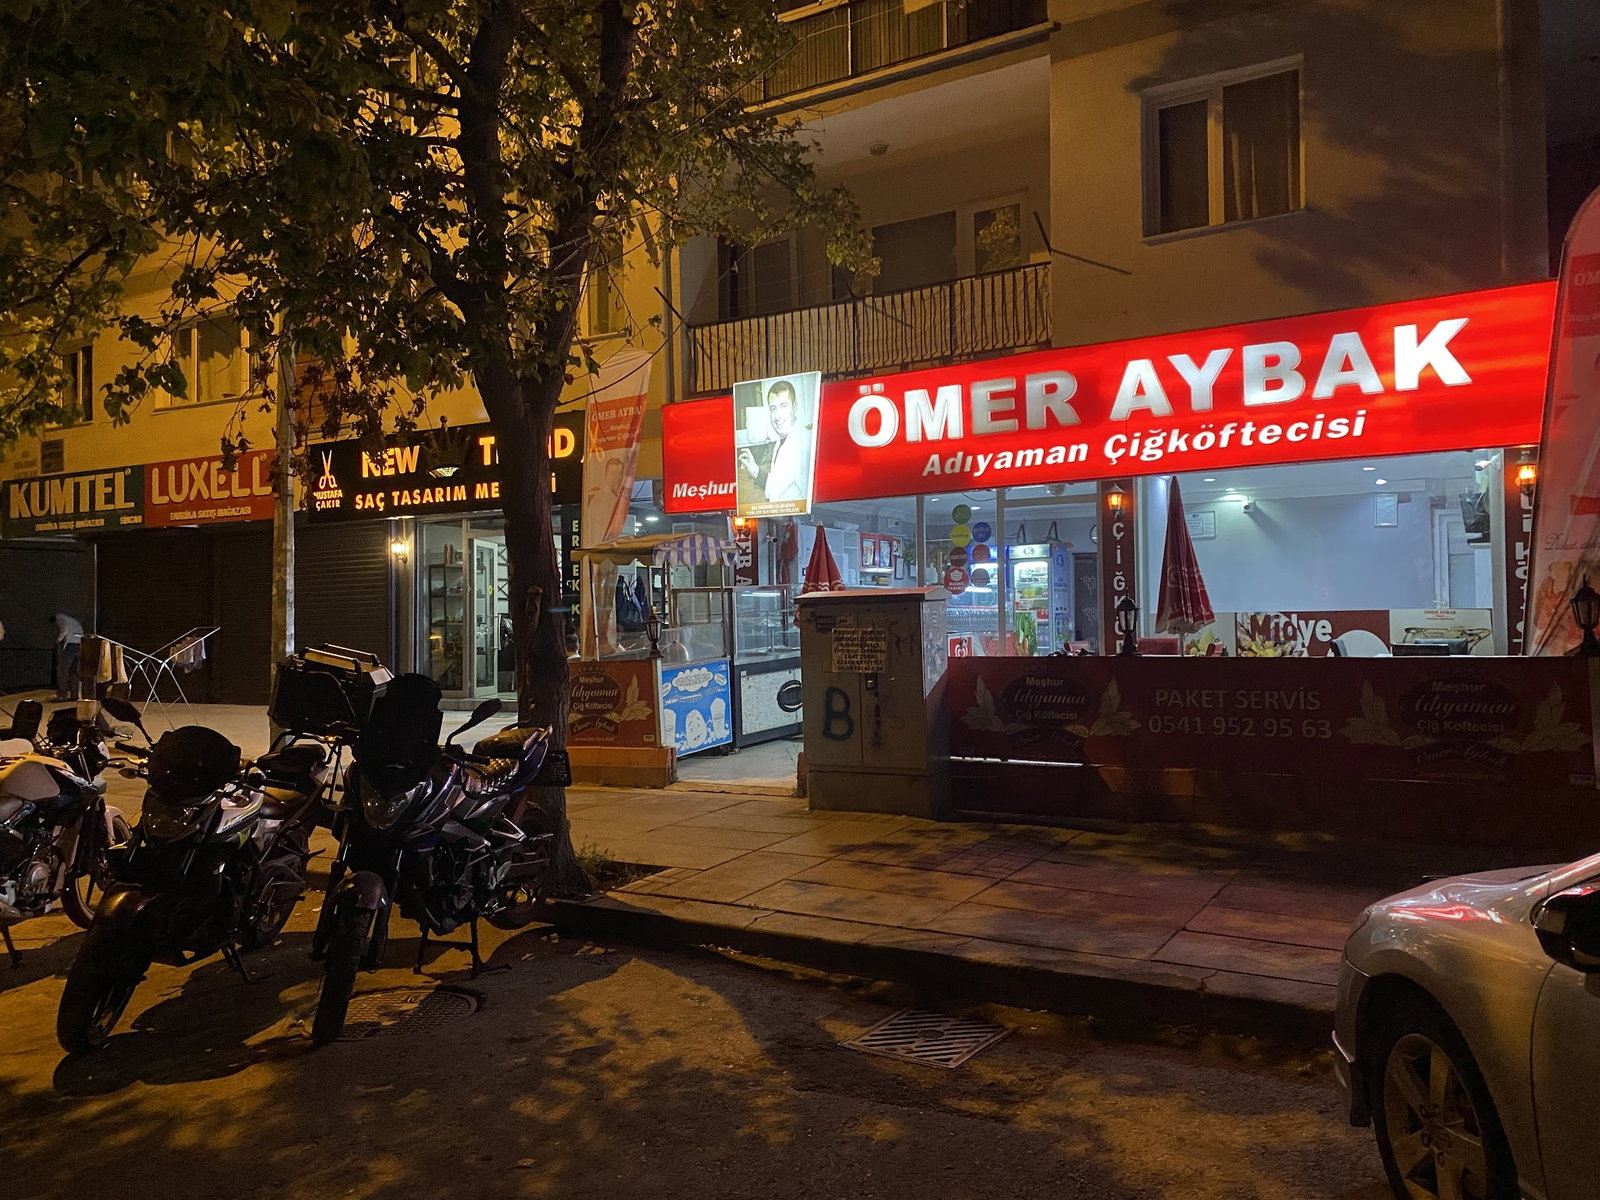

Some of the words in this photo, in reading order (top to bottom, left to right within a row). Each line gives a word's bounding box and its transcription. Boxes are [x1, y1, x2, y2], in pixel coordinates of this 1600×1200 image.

[847, 371, 1078, 449] ÖMER
[1109, 317, 1473, 421] AYBAK
[923, 442, 1089, 478] Adıyaman
[1103, 409, 1366, 466] Çiğköftecisi
[361, 445, 420, 478] NEW
[152, 456, 272, 505] LUXELL
[673, 480, 736, 499] Meşhur
[10, 472, 135, 519] KUMTEL
[316, 499, 341, 512] ÇAKIR
[355, 492, 385, 511] SAÇ
[392, 484, 467, 506] TASARIM
[1250, 611, 1333, 650] Midye
[579, 675, 604, 685] Meşhur
[1026, 676, 1064, 688] Meşhur
[1431, 680, 1486, 694] Meşhur
[1155, 689, 1228, 709] PAKET
[1234, 686, 1321, 711] SERVİS
[821, 685, 855, 742] B
[1148, 714, 1205, 736] 0541
[1211, 716, 1257, 737] 952
[1263, 717, 1294, 738] 95
[1301, 718, 1333, 740] 63
